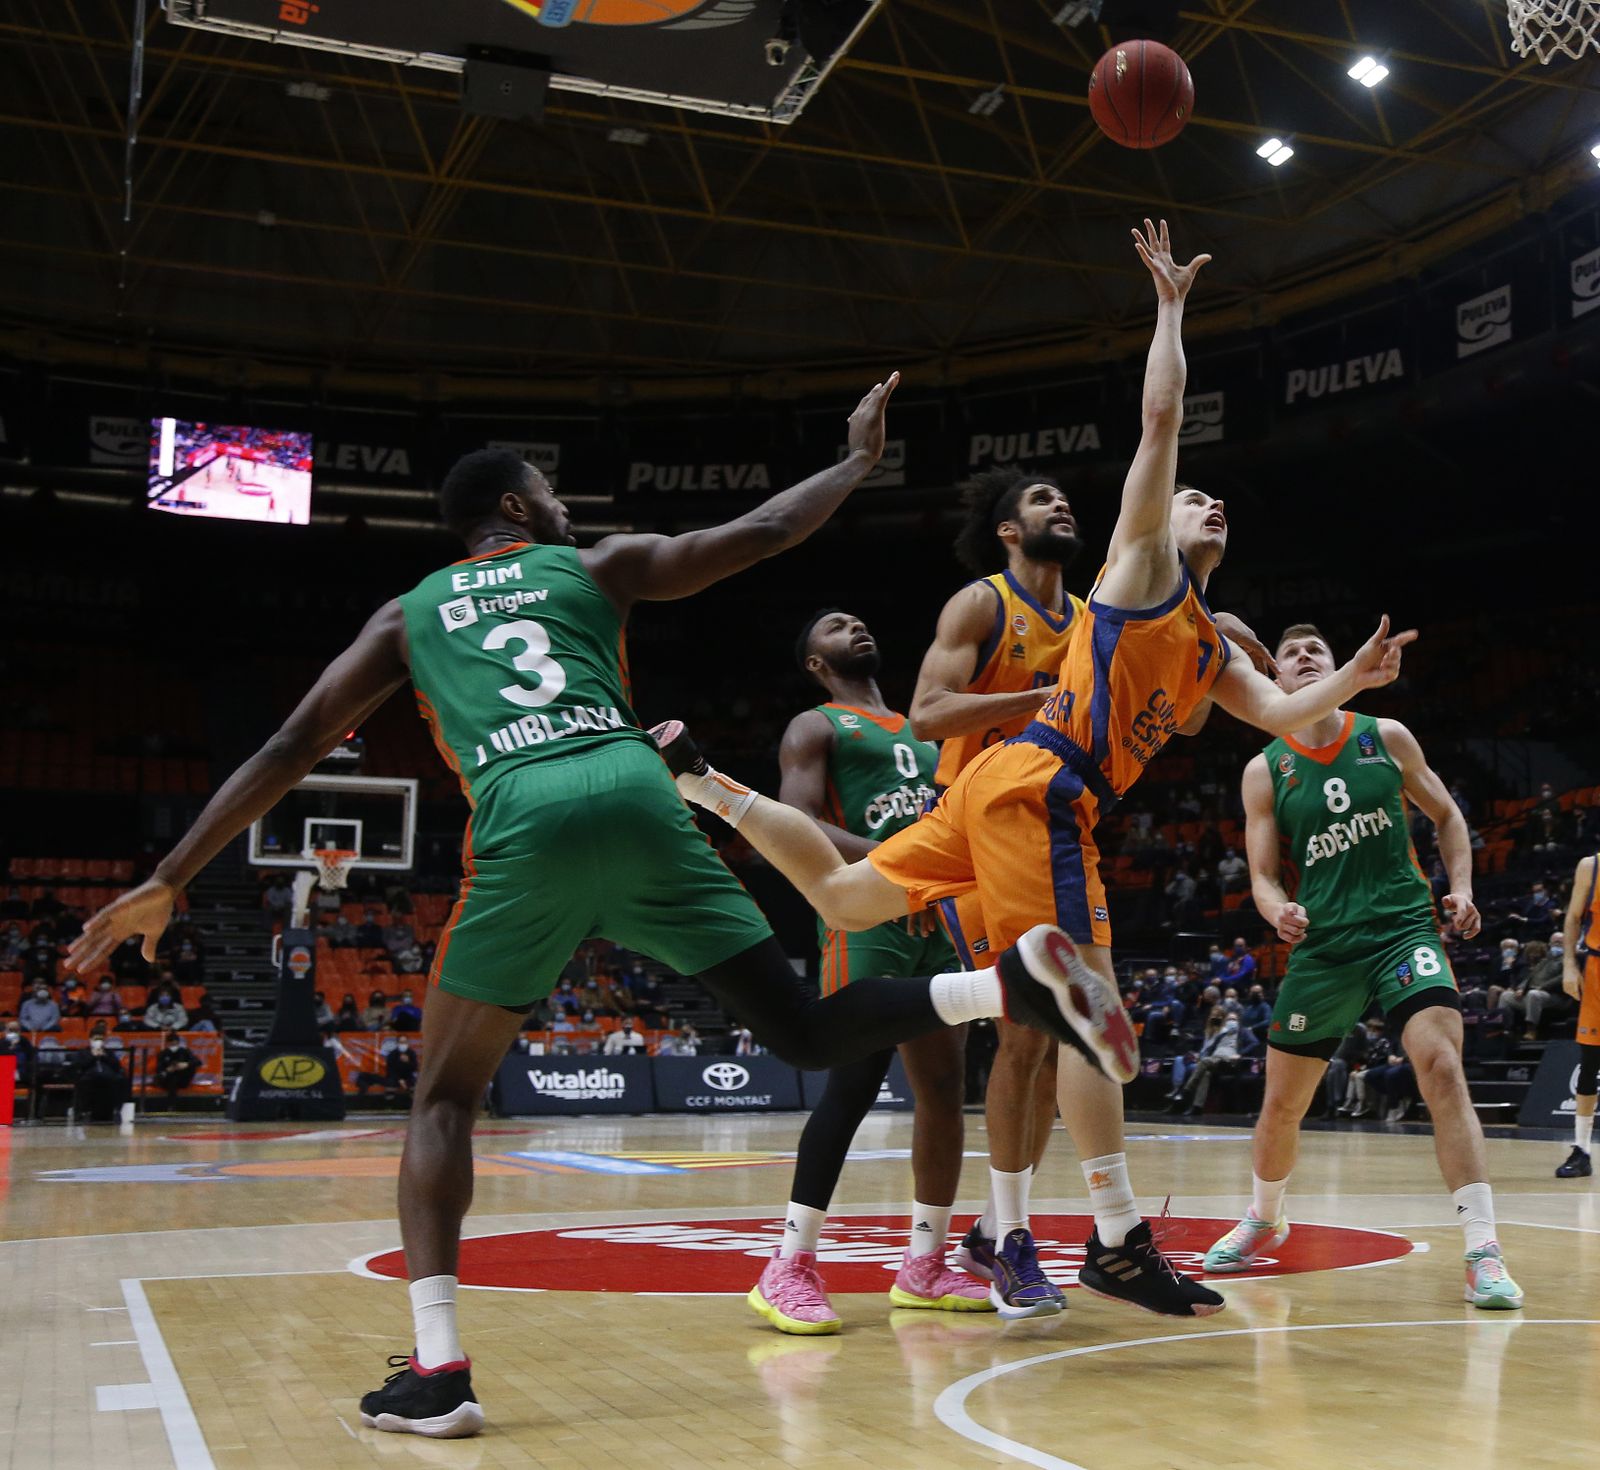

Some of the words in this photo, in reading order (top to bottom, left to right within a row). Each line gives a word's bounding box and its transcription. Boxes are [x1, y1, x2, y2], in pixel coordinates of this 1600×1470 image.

[1460, 295, 1508, 326] PULEVA
[1285, 348, 1405, 405] PULEVA
[312, 442, 412, 477] LEVA
[967, 422, 1100, 467] PULEVA
[626, 461, 771, 493] PULEVA
[451, 562, 524, 593] EJIM
[478, 589, 549, 615] triglav
[481, 619, 567, 708] 3
[893, 743, 919, 779] 0
[1323, 777, 1351, 814] 8
[1413, 946, 1442, 977] 8
[270, 1059, 316, 1082] AP
[527, 1067, 626, 1090] Vitaldin
[580, 1088, 625, 1100] SPORT
[686, 1095, 711, 1107] CCF
[714, 1094, 772, 1107] MONTALT
